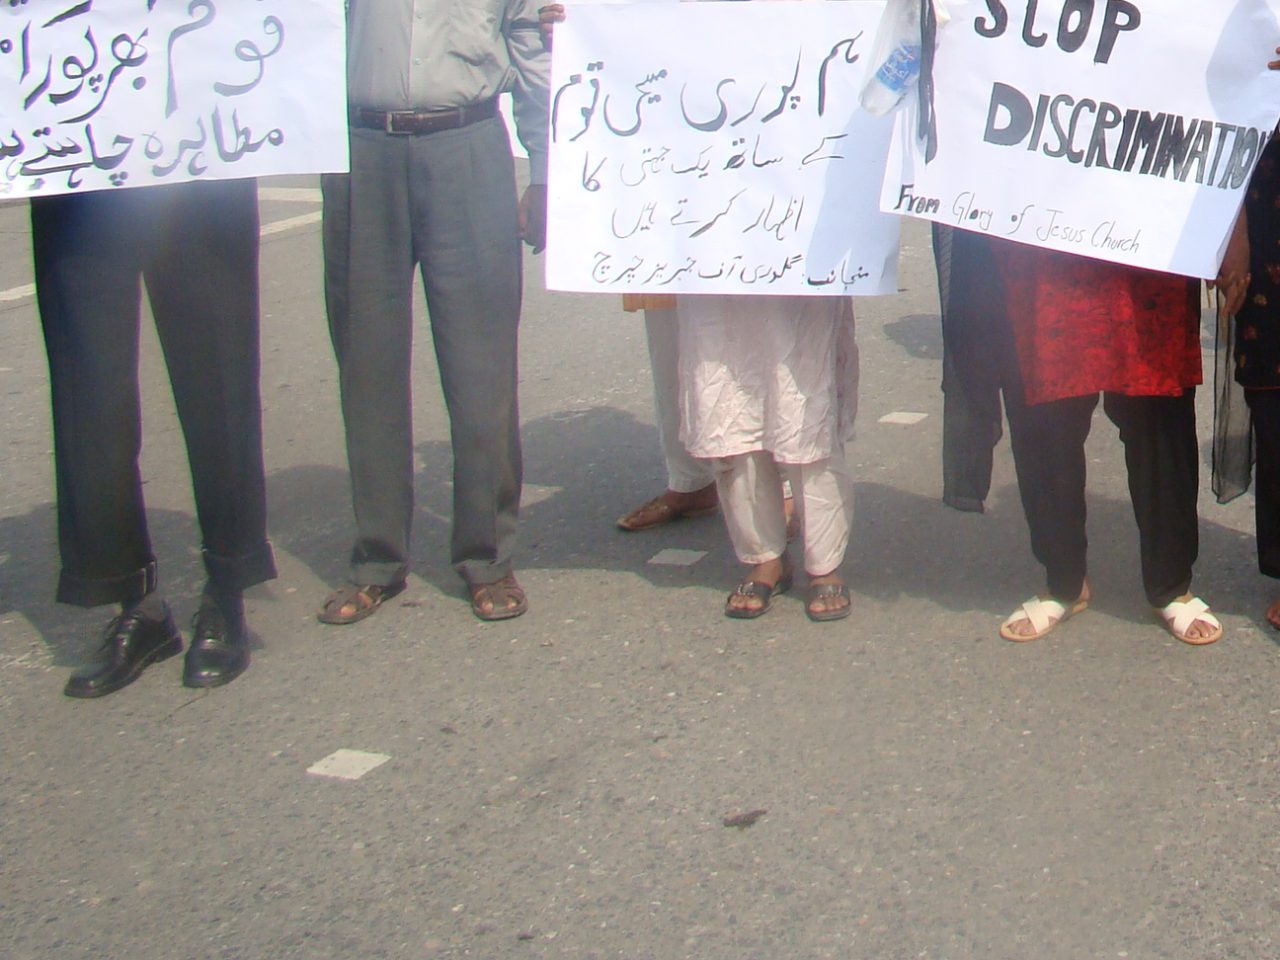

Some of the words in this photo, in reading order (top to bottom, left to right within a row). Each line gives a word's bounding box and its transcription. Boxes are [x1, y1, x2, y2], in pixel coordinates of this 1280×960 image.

[681, 44, 802, 132] پوری
[817, 30, 864, 118] ہم
[551, 61, 604, 143] قوم
[582, 150, 608, 192] کا
[723, 134, 784, 171] ساتھ
[802, 133, 848, 165] کے
[611, 200, 658, 239] ہیں
[670, 188, 748, 238] کرتے
[952, 191, 994, 231] Glory
[1007, 204, 1035, 235] of
[1036, 209, 1087, 243] Jesus
[1091, 220, 1142, 254] Church
